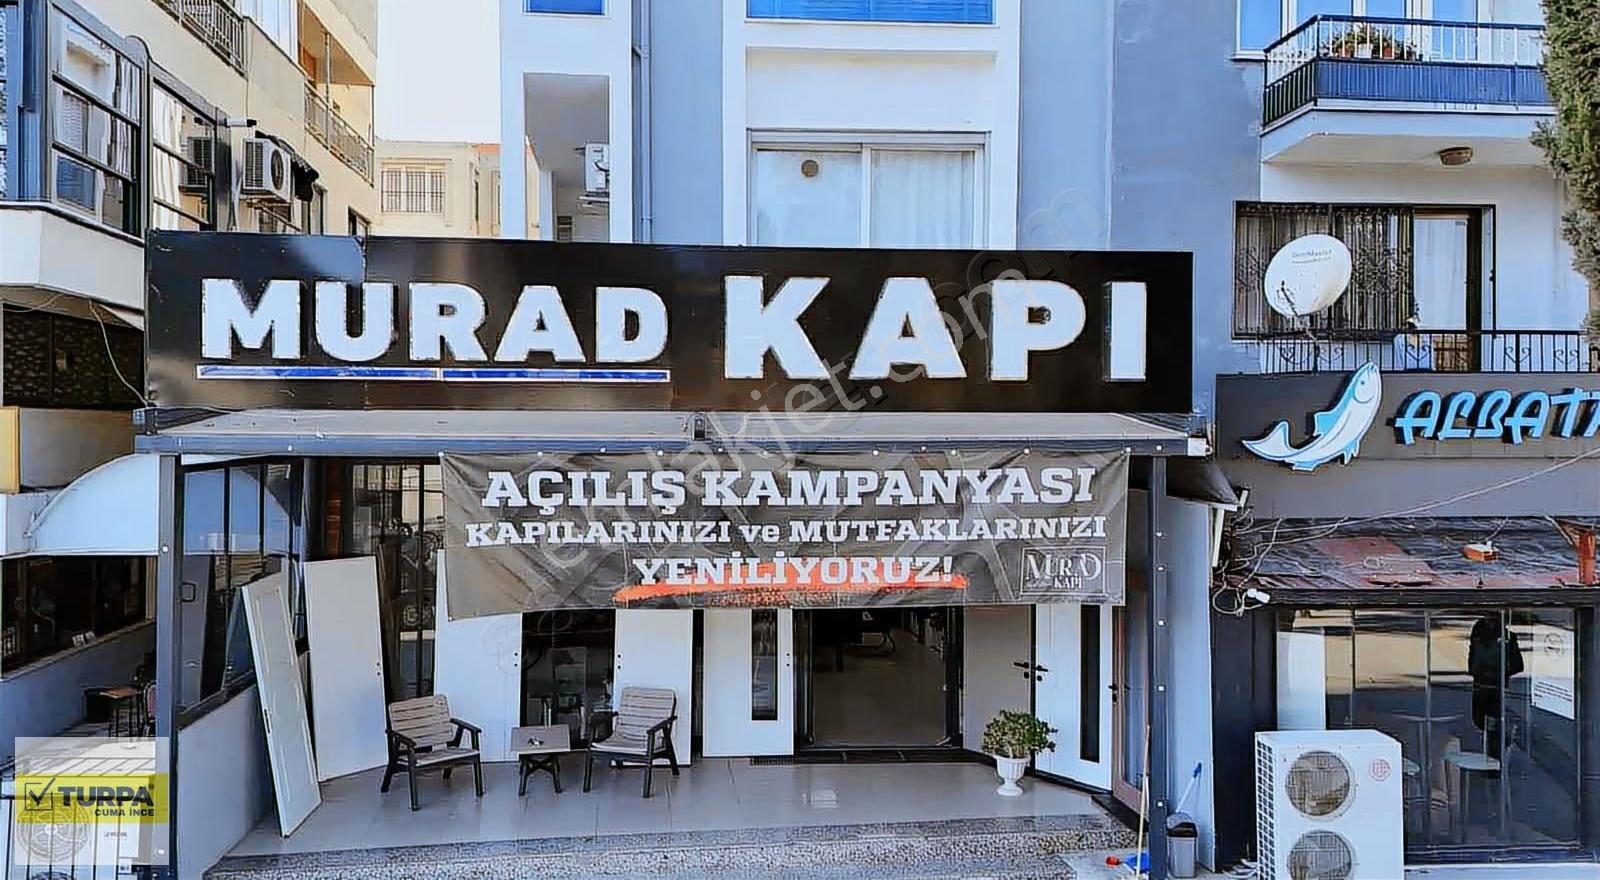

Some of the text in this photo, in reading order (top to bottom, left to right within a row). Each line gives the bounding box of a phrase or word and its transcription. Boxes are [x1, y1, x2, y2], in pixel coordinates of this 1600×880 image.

[201, 275, 1146, 381] MURAD KAPI
[481, 467, 1095, 514] AÇILIŞ KAMPANYASI
[465, 516, 1106, 547] KAPILARINIZI ve MUTFAKLARINIZI
[632, 551, 952, 585] YENİLİYORUZ!
